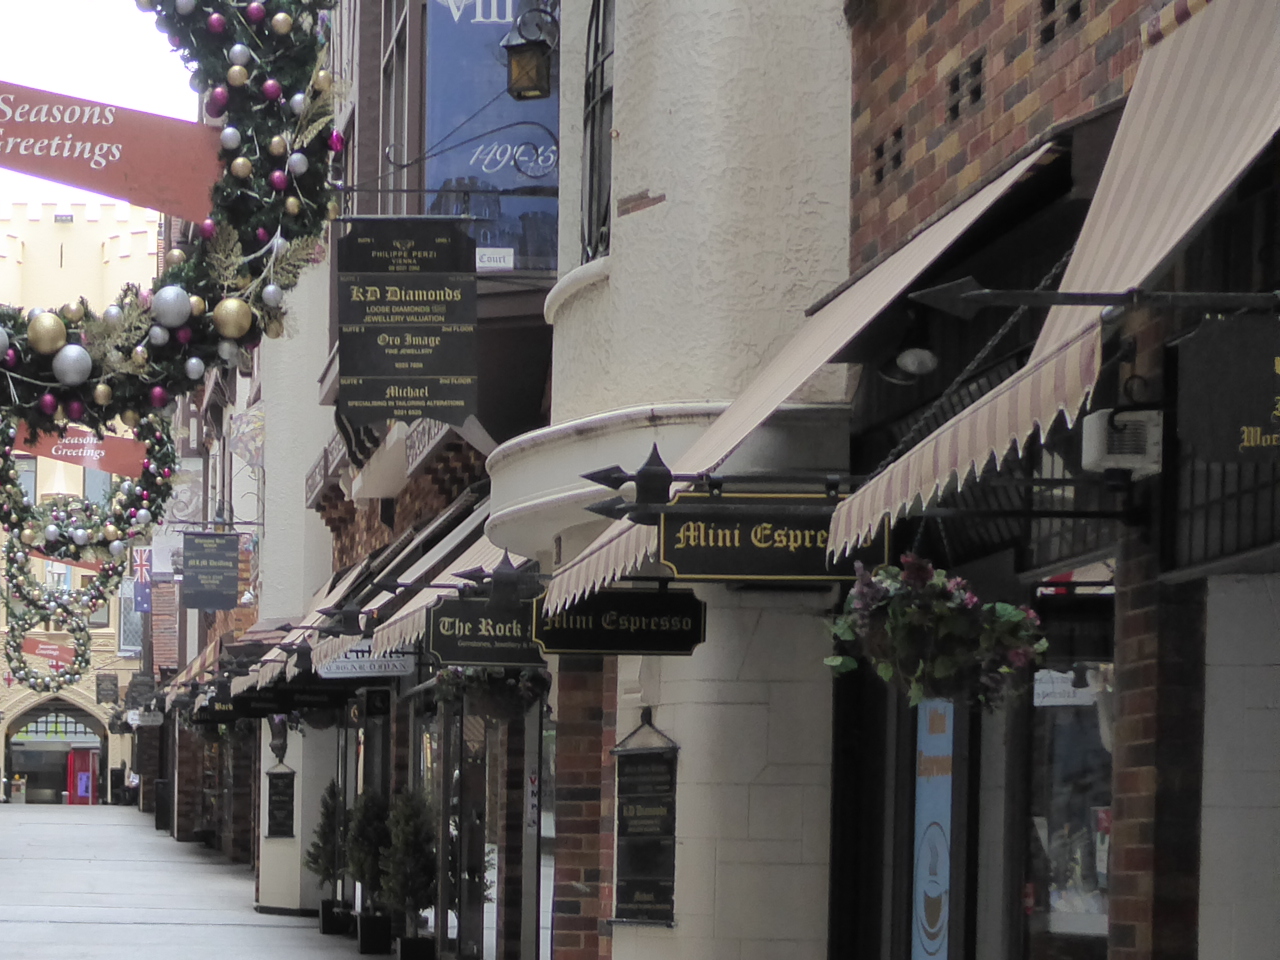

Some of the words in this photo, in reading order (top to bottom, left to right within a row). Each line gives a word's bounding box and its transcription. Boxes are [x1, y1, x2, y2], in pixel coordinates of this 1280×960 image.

[478, 253, 506, 263] Court
[385, 286, 462, 301] Diamonds
[363, 315, 404, 323] JEWELLERY
[406, 315, 445, 323] VALUATION
[377, 333, 401, 346] Oro
[404, 333, 441, 347] Image
[384, 385, 429, 399] Michael
[51, 444, 106, 460] Greetings
[673, 520, 740, 549] Mini
[439, 616, 472, 638] The
[477, 617, 522, 637] Rock
[601, 611, 692, 633] Espresso
